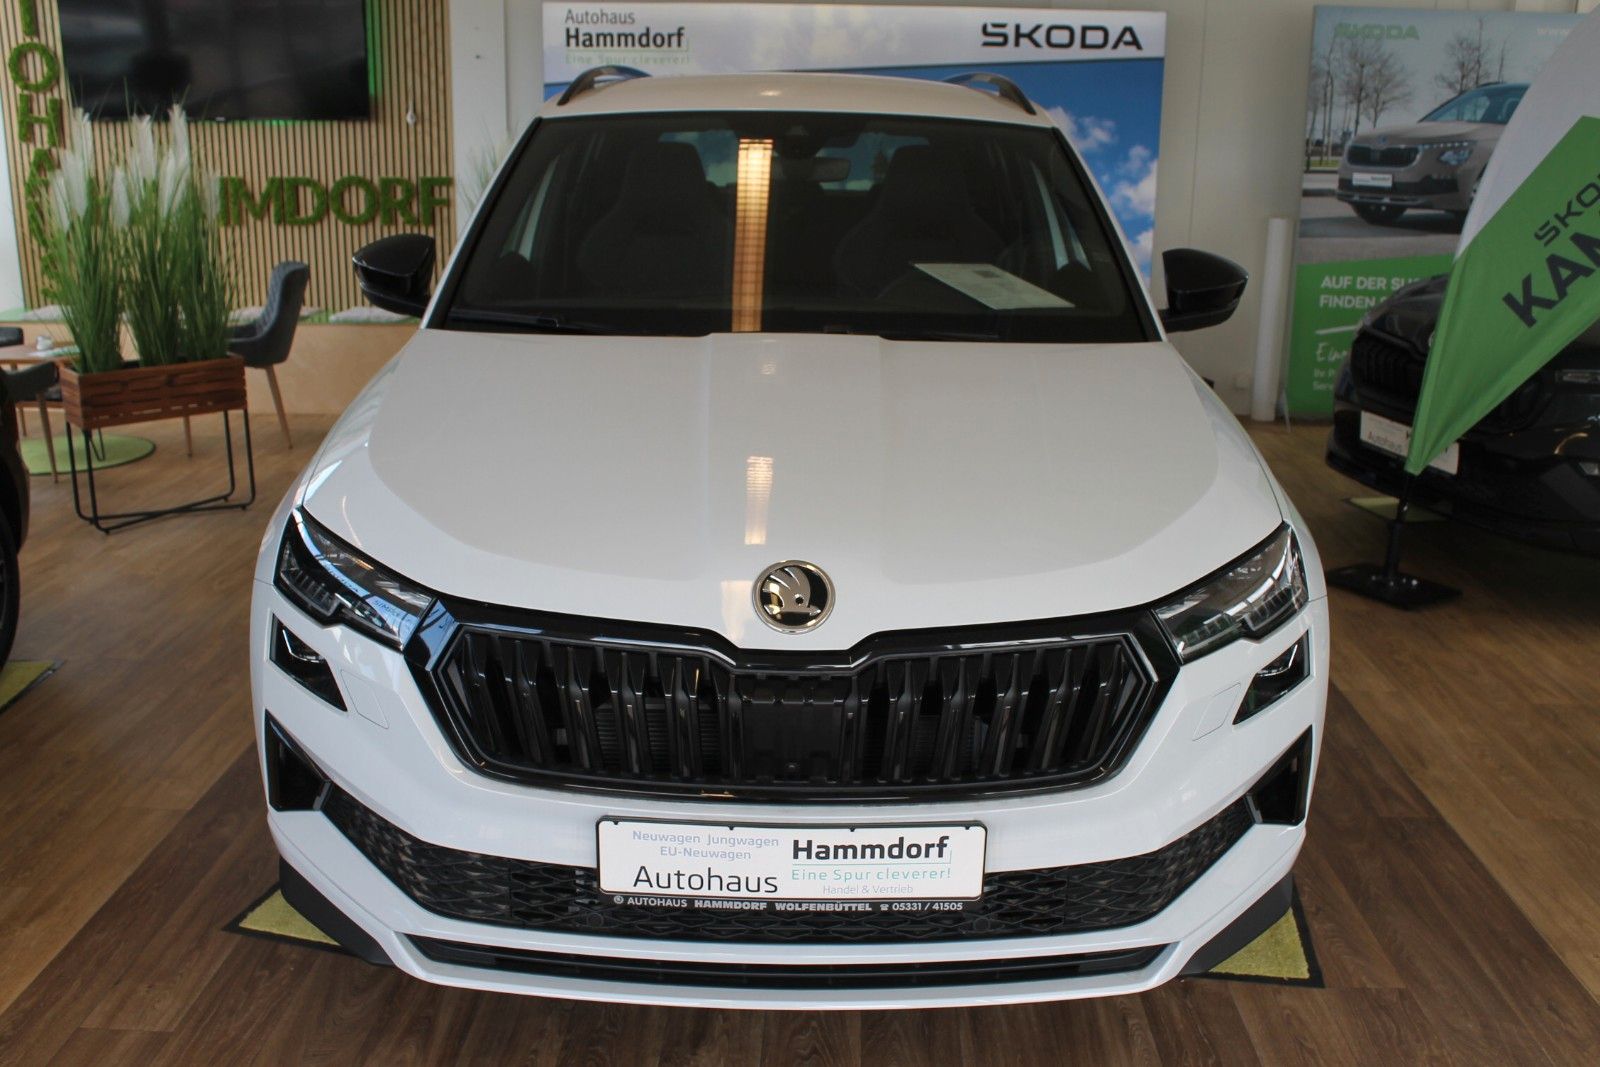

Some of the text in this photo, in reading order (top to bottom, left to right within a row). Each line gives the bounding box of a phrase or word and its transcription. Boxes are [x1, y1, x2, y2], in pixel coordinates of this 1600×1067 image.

[565, 9, 636, 24] Autohaus
[565, 27, 686, 48] Hammdorf
[1534, 173, 1600, 247] SKO
[1321, 275, 1353, 289] AUF
[1356, 277, 1388, 290] DER
[1319, 294, 1377, 308] FINDEN
[632, 830, 779, 847] Neuwagen Jungwagen
[660, 846, 752, 861] EU-Neuwagen
[793, 835, 950, 860] Hammdorf
[633, 865, 778, 893] Autohaus
[791, 868, 951, 882] Eine Spur cleverer!
[822, 885, 914, 895] Handel & Vertrieb
[627, 896, 688, 908] AUTOHAUS
[694, 900, 768, 910] HAMMDORF
[775, 901, 873, 912] WOLFENBÜTTEL
[892, 902, 922, 911] 05331
[932, 902, 964, 911] 41505
